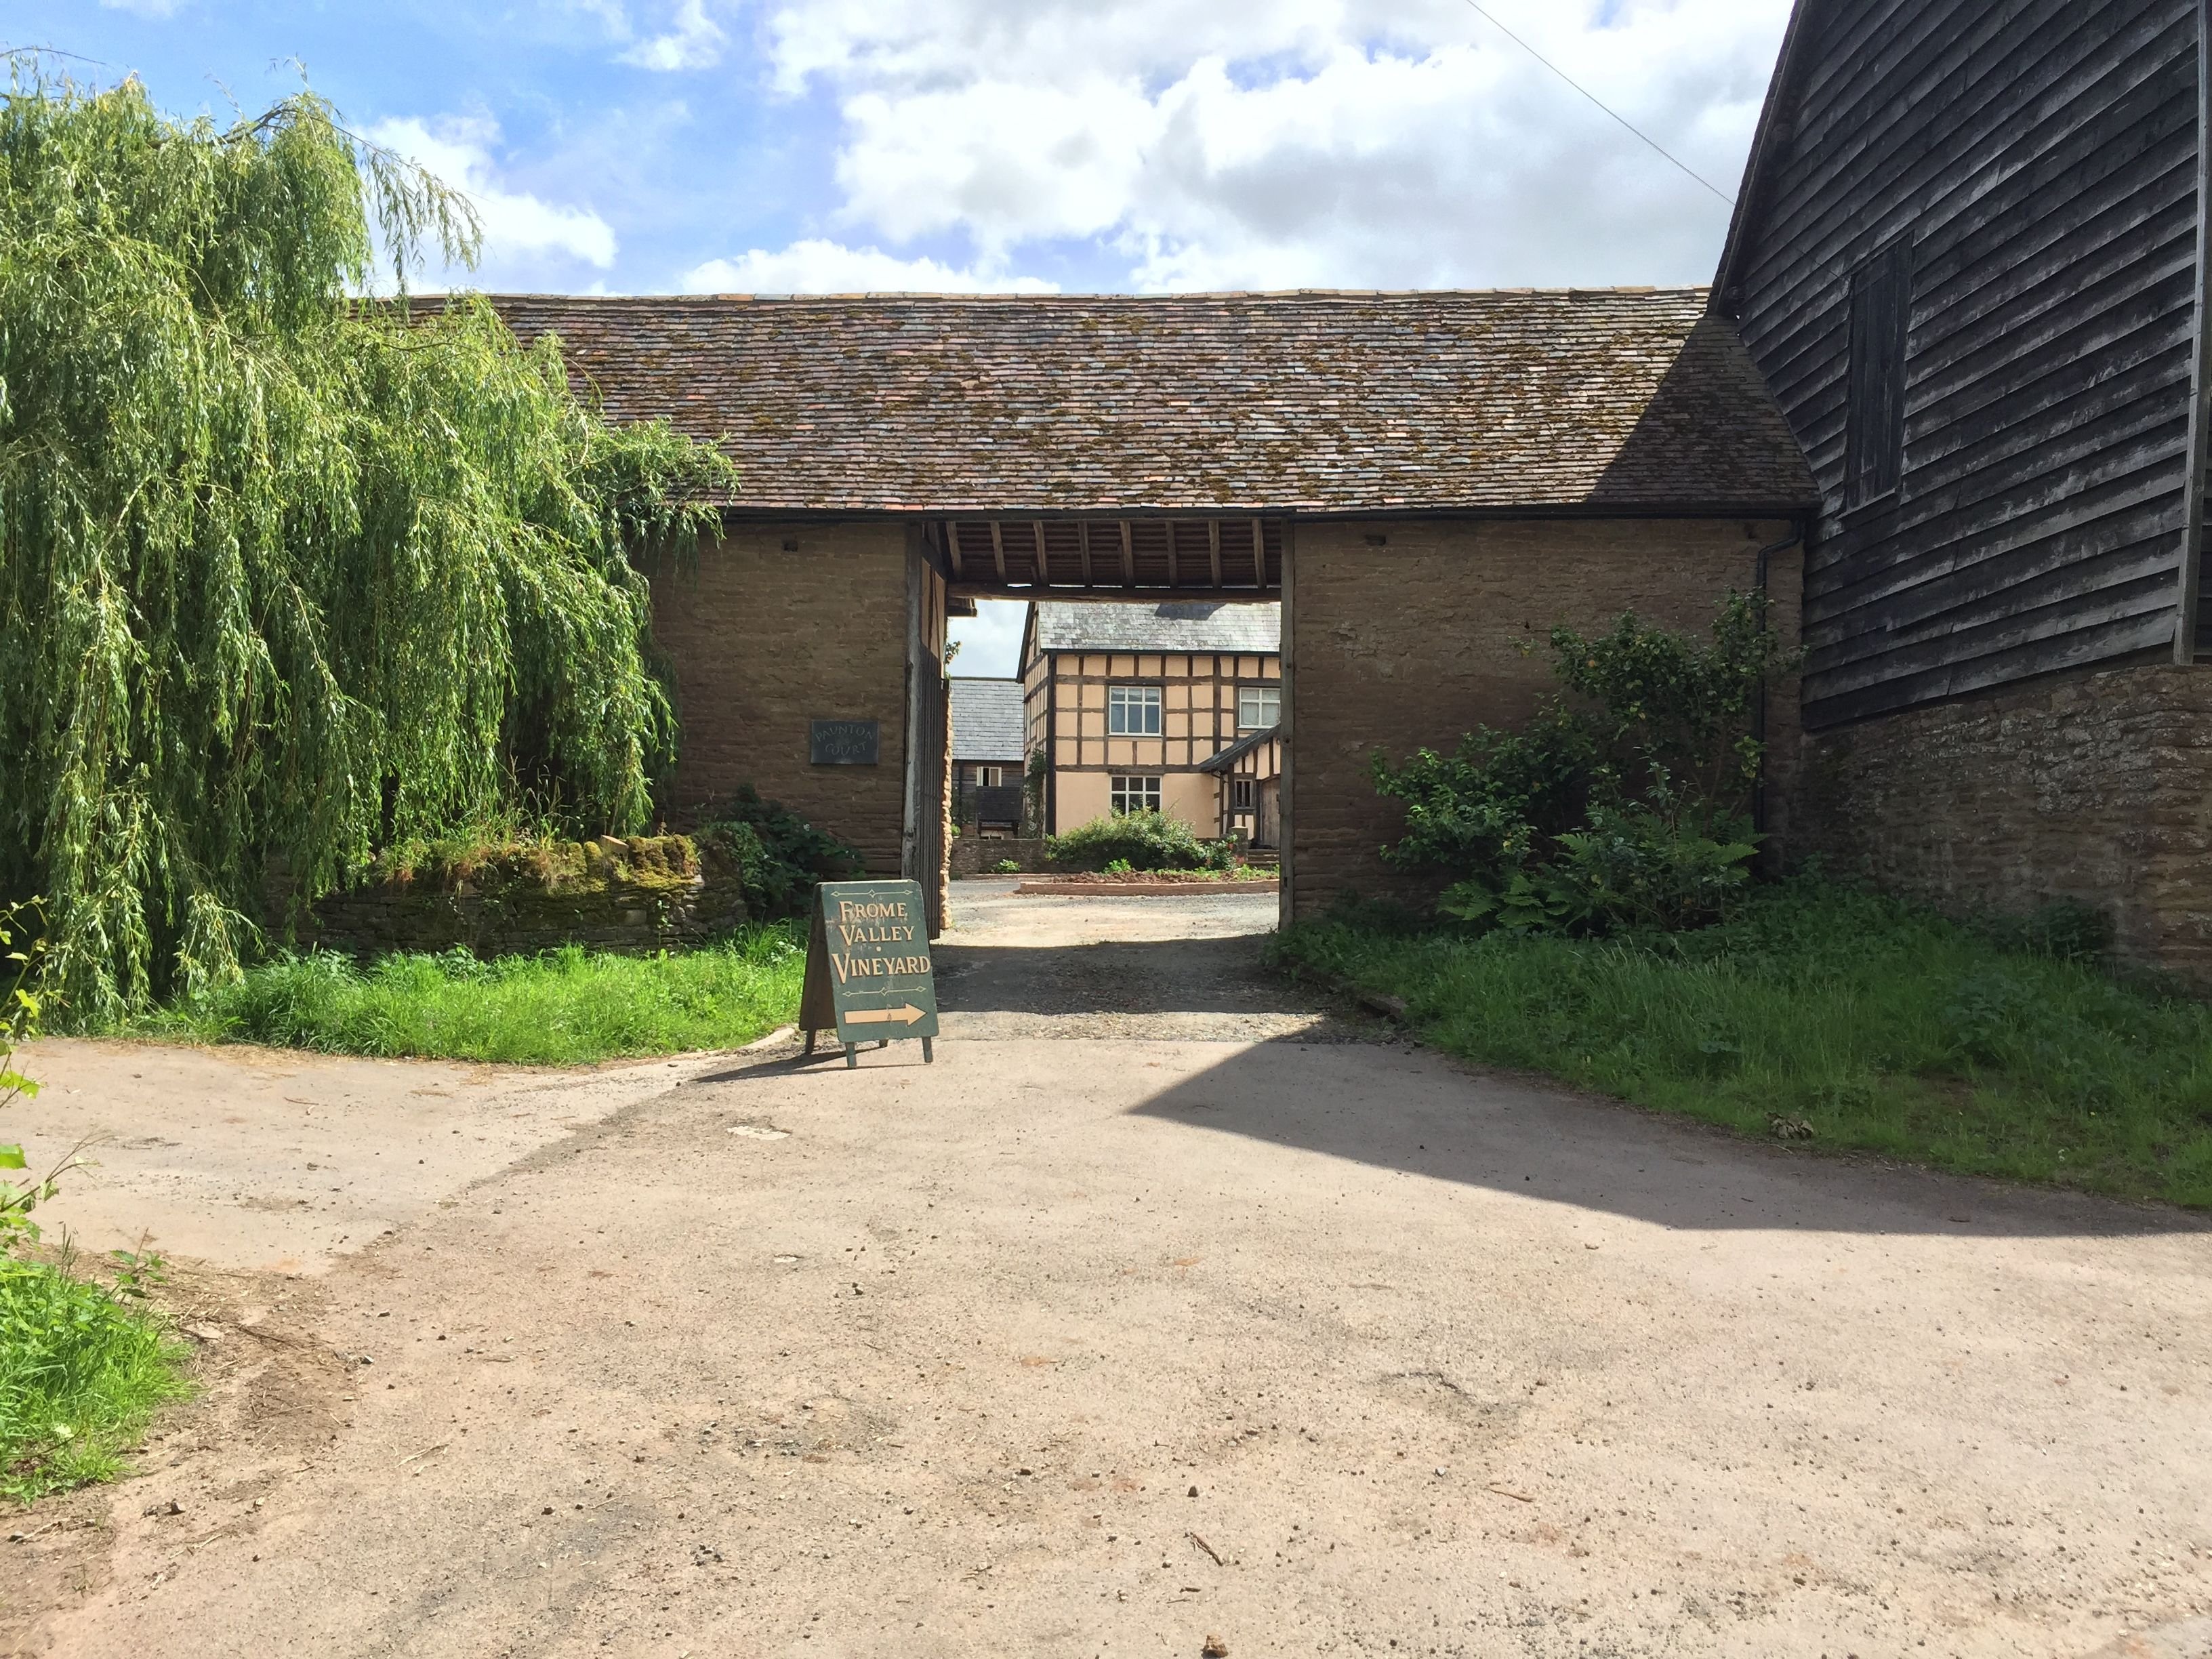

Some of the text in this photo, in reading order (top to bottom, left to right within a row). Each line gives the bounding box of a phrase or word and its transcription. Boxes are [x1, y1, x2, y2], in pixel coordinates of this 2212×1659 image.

[825, 741, 867, 756] COURT
[839, 901, 908, 923] FROME
[839, 924, 915, 946] VALLEY
[831, 953, 931, 985] VINEYARD
